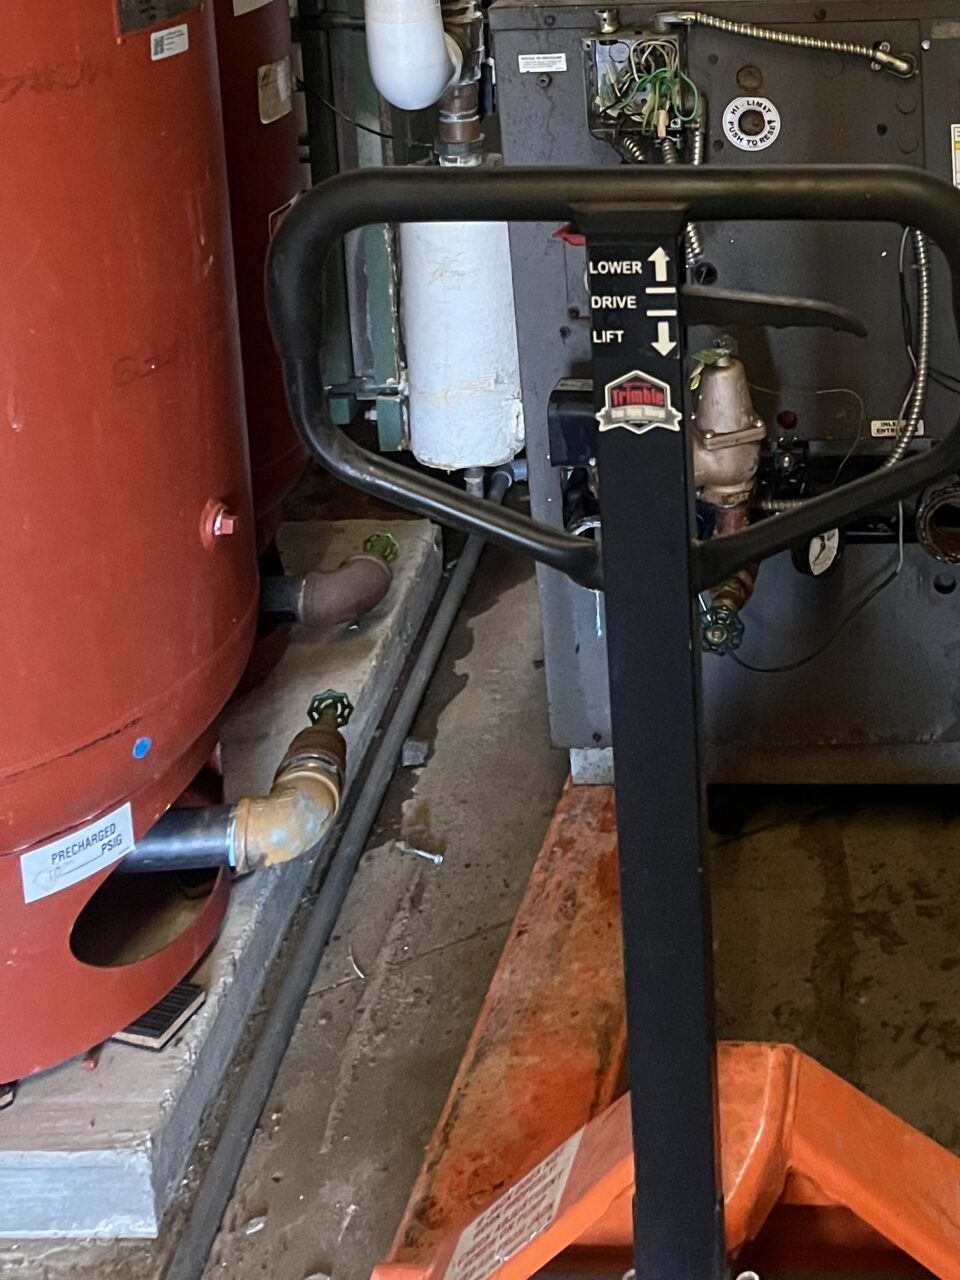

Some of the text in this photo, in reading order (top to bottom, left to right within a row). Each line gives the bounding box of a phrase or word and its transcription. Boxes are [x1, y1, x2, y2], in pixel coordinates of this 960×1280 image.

[730, 100, 772, 116] HI LIMIT
[728, 121, 744, 143] PUSH
[759, 120, 776, 143] RESET
[588, 260, 643, 275] LOWER
[591, 295, 638, 309] DRIVE
[593, 330, 625, 344] LIFT
[612, 387, 665, 407] Trimble
[50, 823, 117, 866] PRECHARGED
[100, 834, 123, 855] PSIG
